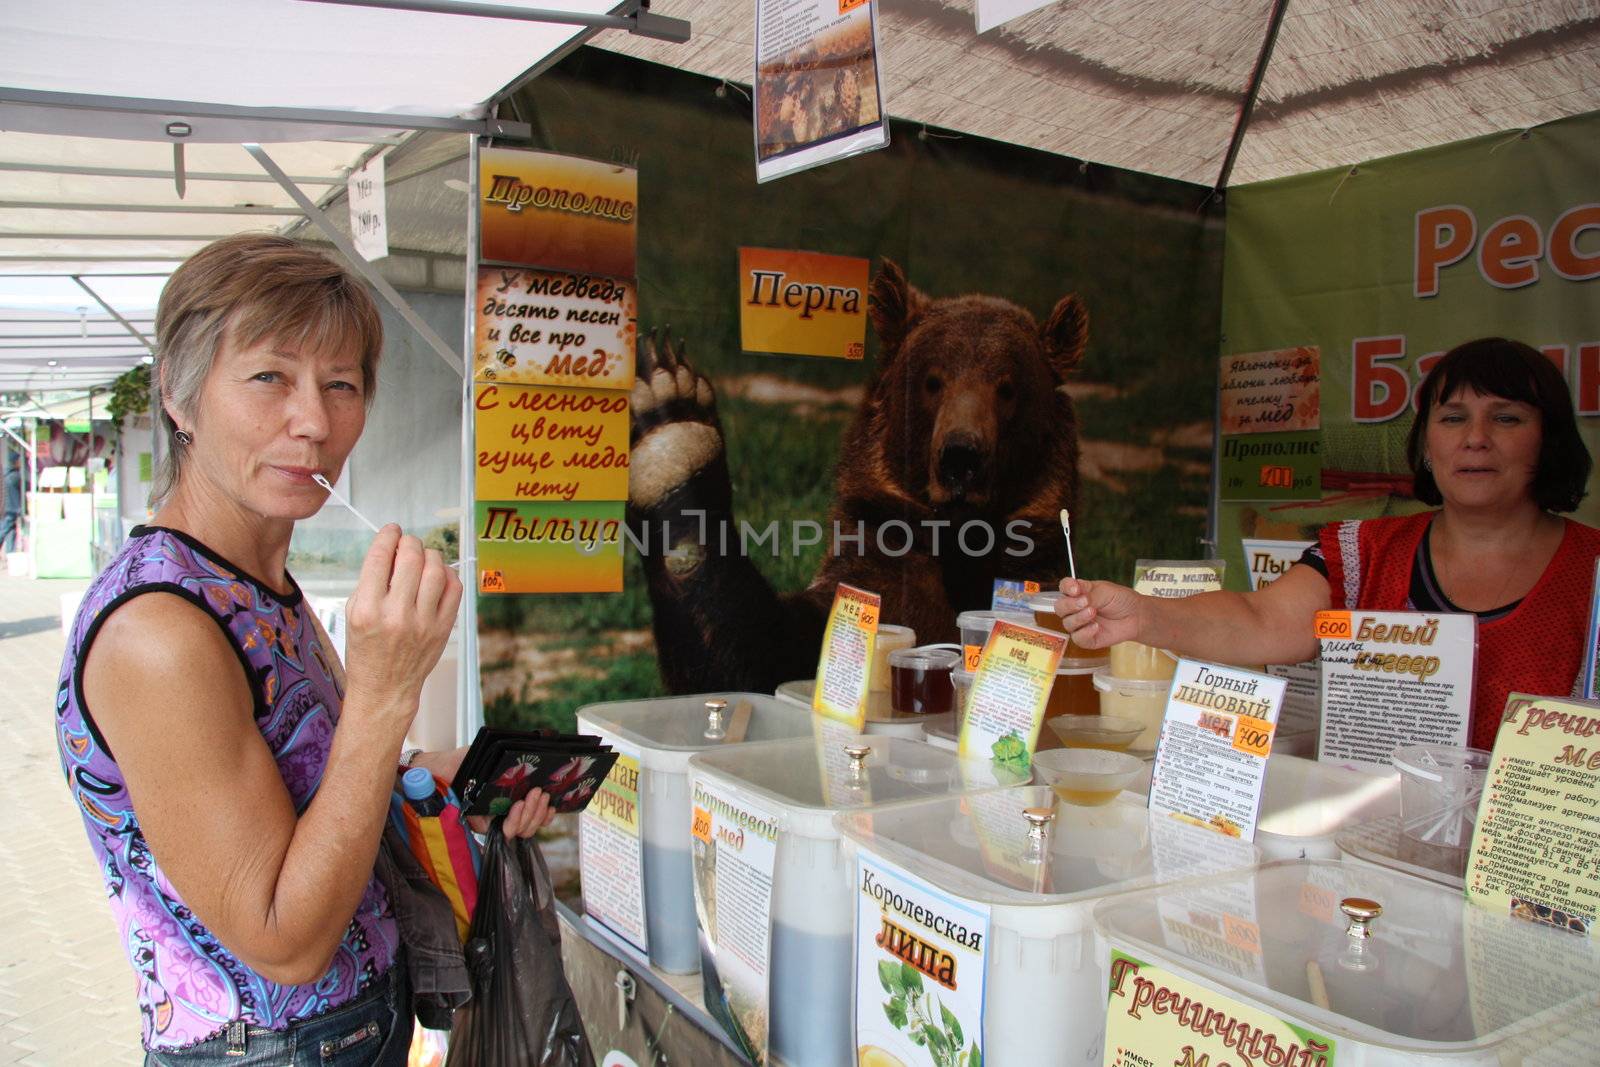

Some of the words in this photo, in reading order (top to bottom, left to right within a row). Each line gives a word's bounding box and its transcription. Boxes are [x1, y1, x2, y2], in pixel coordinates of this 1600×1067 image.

[485, 174, 635, 221] Прополис
[496, 271, 520, 293] У
[527, 274, 626, 301] медведя
[748, 271, 860, 319] Перга
[483, 298, 559, 319] десять
[566, 308, 620, 325] песен
[487, 327, 499, 341] и
[509, 324, 541, 344] все
[548, 333, 586, 351] про
[544, 349, 610, 377] мед.
[476, 385, 500, 411] С
[509, 392, 628, 414] лесного
[511, 416, 604, 447] цвету
[478, 450, 554, 474] гуще
[562, 446, 631, 469] меда
[1223, 438, 1321, 461] Прополис
[515, 481, 580, 501] нету
[480, 507, 620, 549] Пыльца
[1318, 621, 1348, 635] 600
[1356, 616, 1440, 646] Белый
[968, 655, 980, 668] 10
[1195, 666, 1258, 696] Горный
[1503, 700, 1600, 738] Гречи
[1240, 727, 1269, 749] 700
[1508, 757, 1536, 767] имеет
[1492, 783, 1527, 796] желудка
[1504, 771, 1532, 783] крови
[1506, 764, 1552, 778] повышает
[1555, 774, 1595, 789] уровень
[1488, 798, 1514, 809] ление
[1502, 778, 1561, 797] нормализует
[1564, 792, 1600, 808] работу
[1495, 807, 1534, 821] является
[1499, 793, 1557, 811] нормализует
[1561, 808, 1600, 824] артериа
[1480, 827, 1502, 838] медь
[1493, 815, 1537, 831] содержит
[1539, 827, 1573, 841] железо
[1476, 849, 1530, 869] малокровия
[1491, 845, 1559, 869] рекомендуется
[1563, 866, 1582, 876] для
[1492, 838, 1538, 855] витамины
[1473, 863, 1535, 886] заболеваниях
[1540, 883, 1569, 896] крови
[1484, 882, 1500, 892] как
[1488, 860, 1547, 881] применяется
[1551, 879, 1571, 889] при
[1470, 884, 1490, 896] ство
[1486, 874, 1551, 899] расстройствах
[1552, 895, 1597, 913] нервной
[862, 868, 983, 952] Королевская
[875, 917, 958, 988] липа
[1111, 957, 1329, 1067] Гречичный
